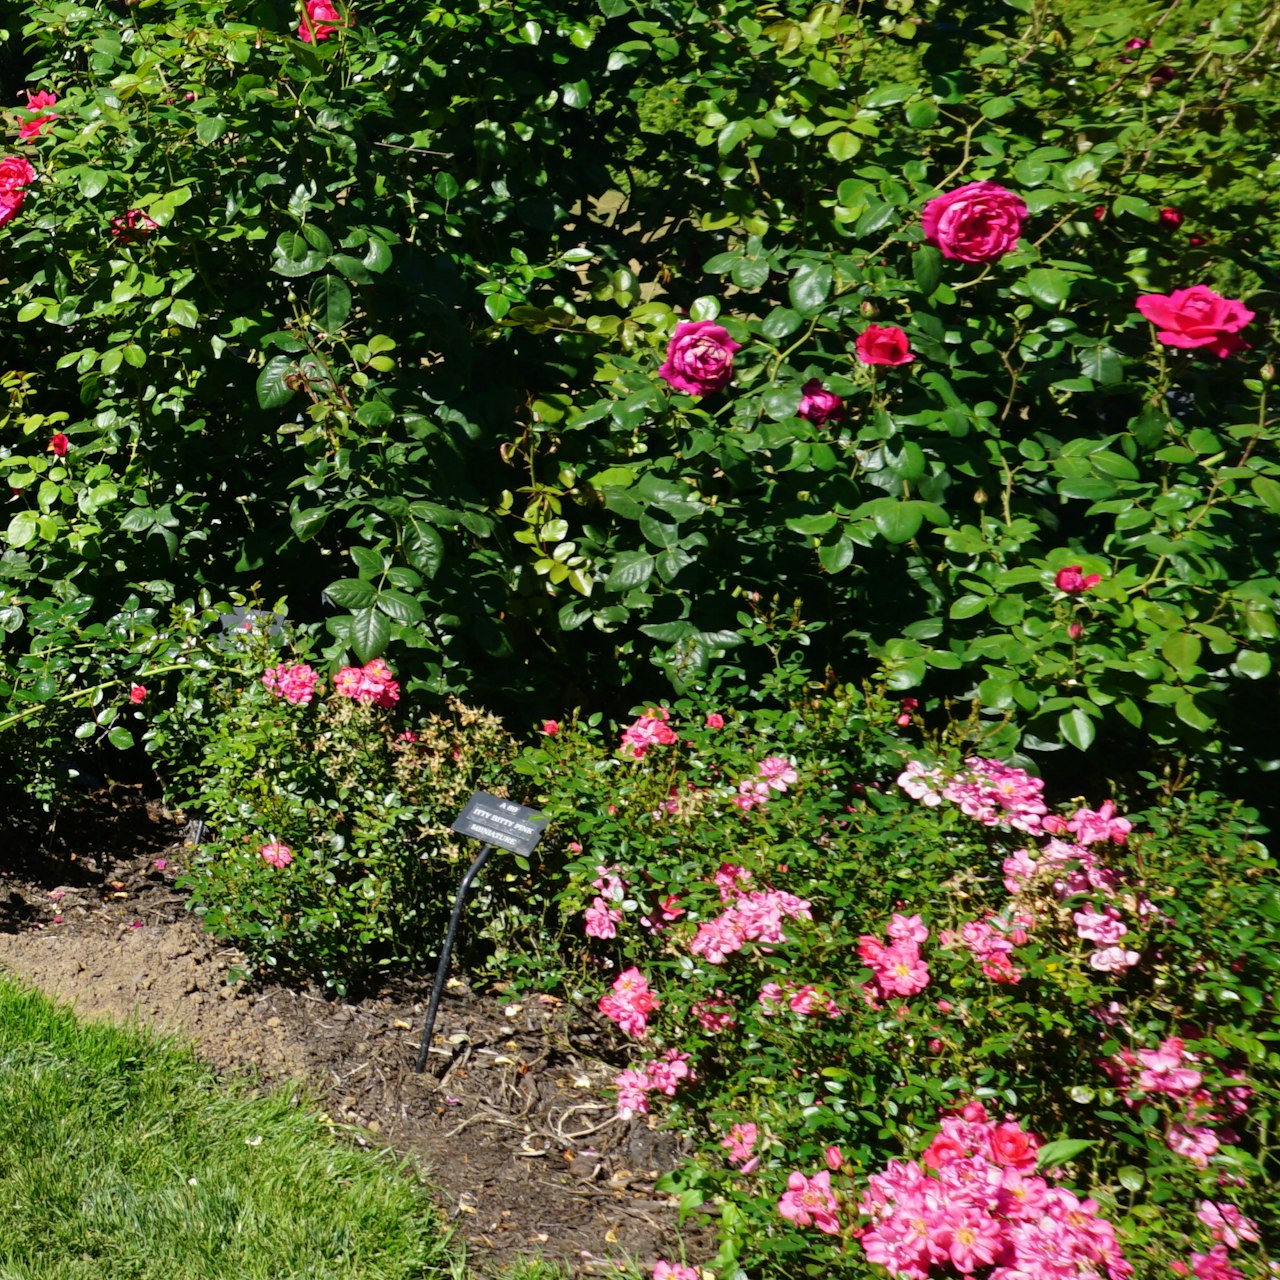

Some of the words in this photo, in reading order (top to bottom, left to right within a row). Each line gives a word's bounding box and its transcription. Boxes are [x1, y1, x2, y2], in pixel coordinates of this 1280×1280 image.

[473, 808, 492, 819] ITTY
[490, 814, 515, 827] BITTY
[513, 823, 535, 835] PINK
[470, 823, 517, 846] MINIATURE
